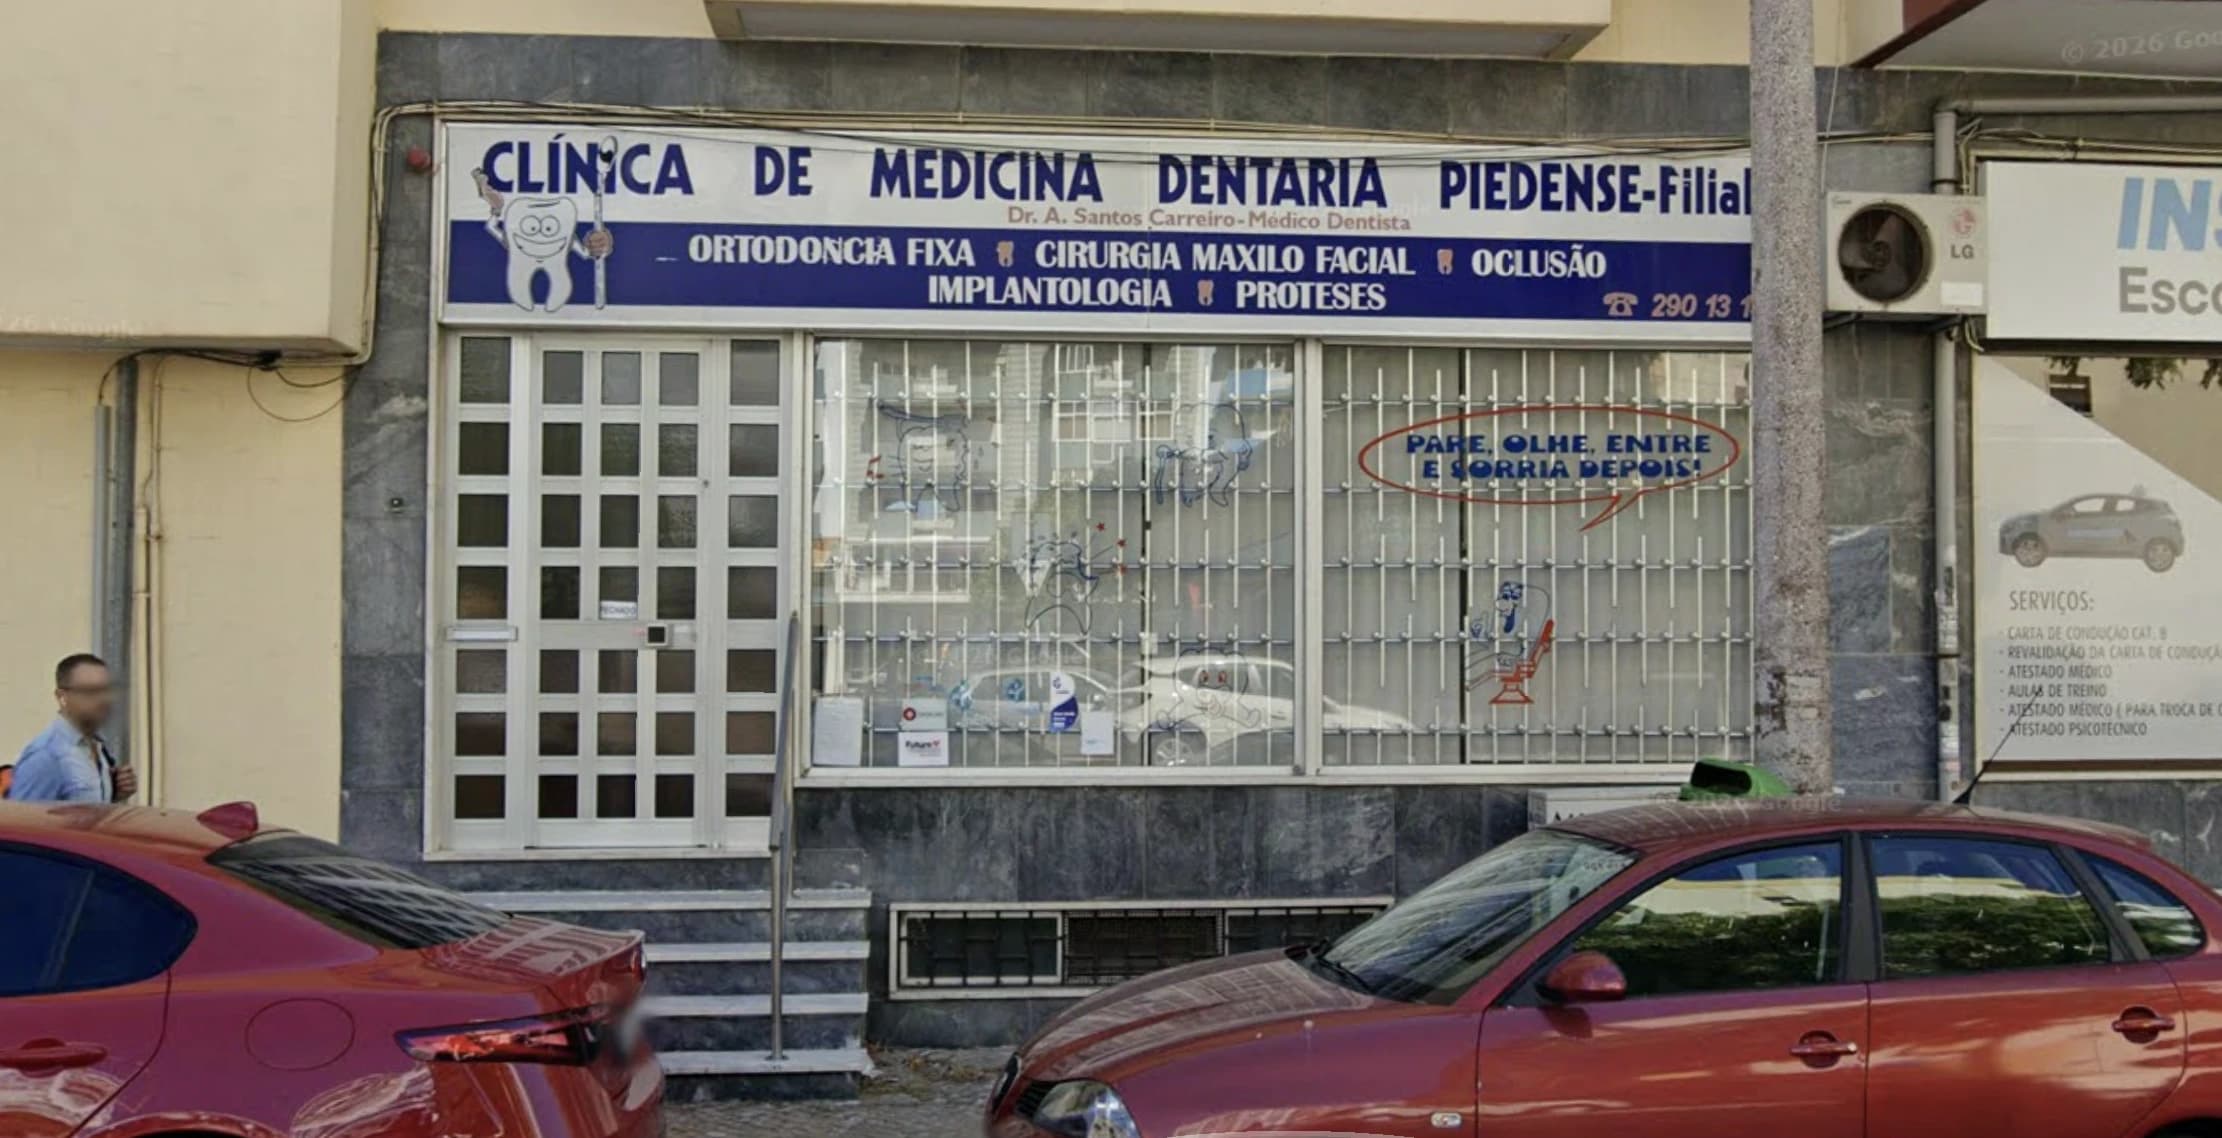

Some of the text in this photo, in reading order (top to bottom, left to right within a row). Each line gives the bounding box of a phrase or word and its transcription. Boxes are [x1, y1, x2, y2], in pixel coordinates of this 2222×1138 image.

[754, 146, 813, 195] DE
[869, 149, 1103, 203] MEDICINA
[1158, 153, 1388, 208] DENTARIA
[1008, 207, 1037, 225] Dr.
[1044, 209, 1067, 225] A.
[1074, 208, 1142, 227] Santos
[1327, 212, 1411, 232] Dentista
[2117, 177, 2222, 251] IN
[689, 235, 1607, 279] ORTODONCIA FIXA CIRURGIA MAXILO FACIAL OCLUSÃO
[1950, 243, 1975, 260] LG
[928, 276, 1387, 310] IMPLANTOLOGIA PROTESES
[1651, 294, 1697, 317] 290
[1705, 295, 1732, 318] 13
[1406, 434, 1712, 456] PARE, OLHE, ENTRE
[1422, 458, 1701, 479] E SORRIA DEPOIS!
[2009, 591, 2095, 615] SERVIÇOS:
[2007, 626, 2044, 641] CARTA
[2047, 626, 2062, 641] DE
[2065, 624, 2129, 643] CONDUÇÃO
[2007, 643, 2086, 661] REVALIDAÇÃO
[2110, 646, 2147, 660] CARTA
[2149, 646, 2163, 660] DE
[2007, 665, 2065, 679] ATESTADO
[2048, 684, 2063, 698] DE
[2067, 684, 2107, 698] TREINO
[2007, 704, 2065, 718] ATESTADO
[2159, 702, 2196, 716] TROCA
[2200, 703, 2213, 717] DE
